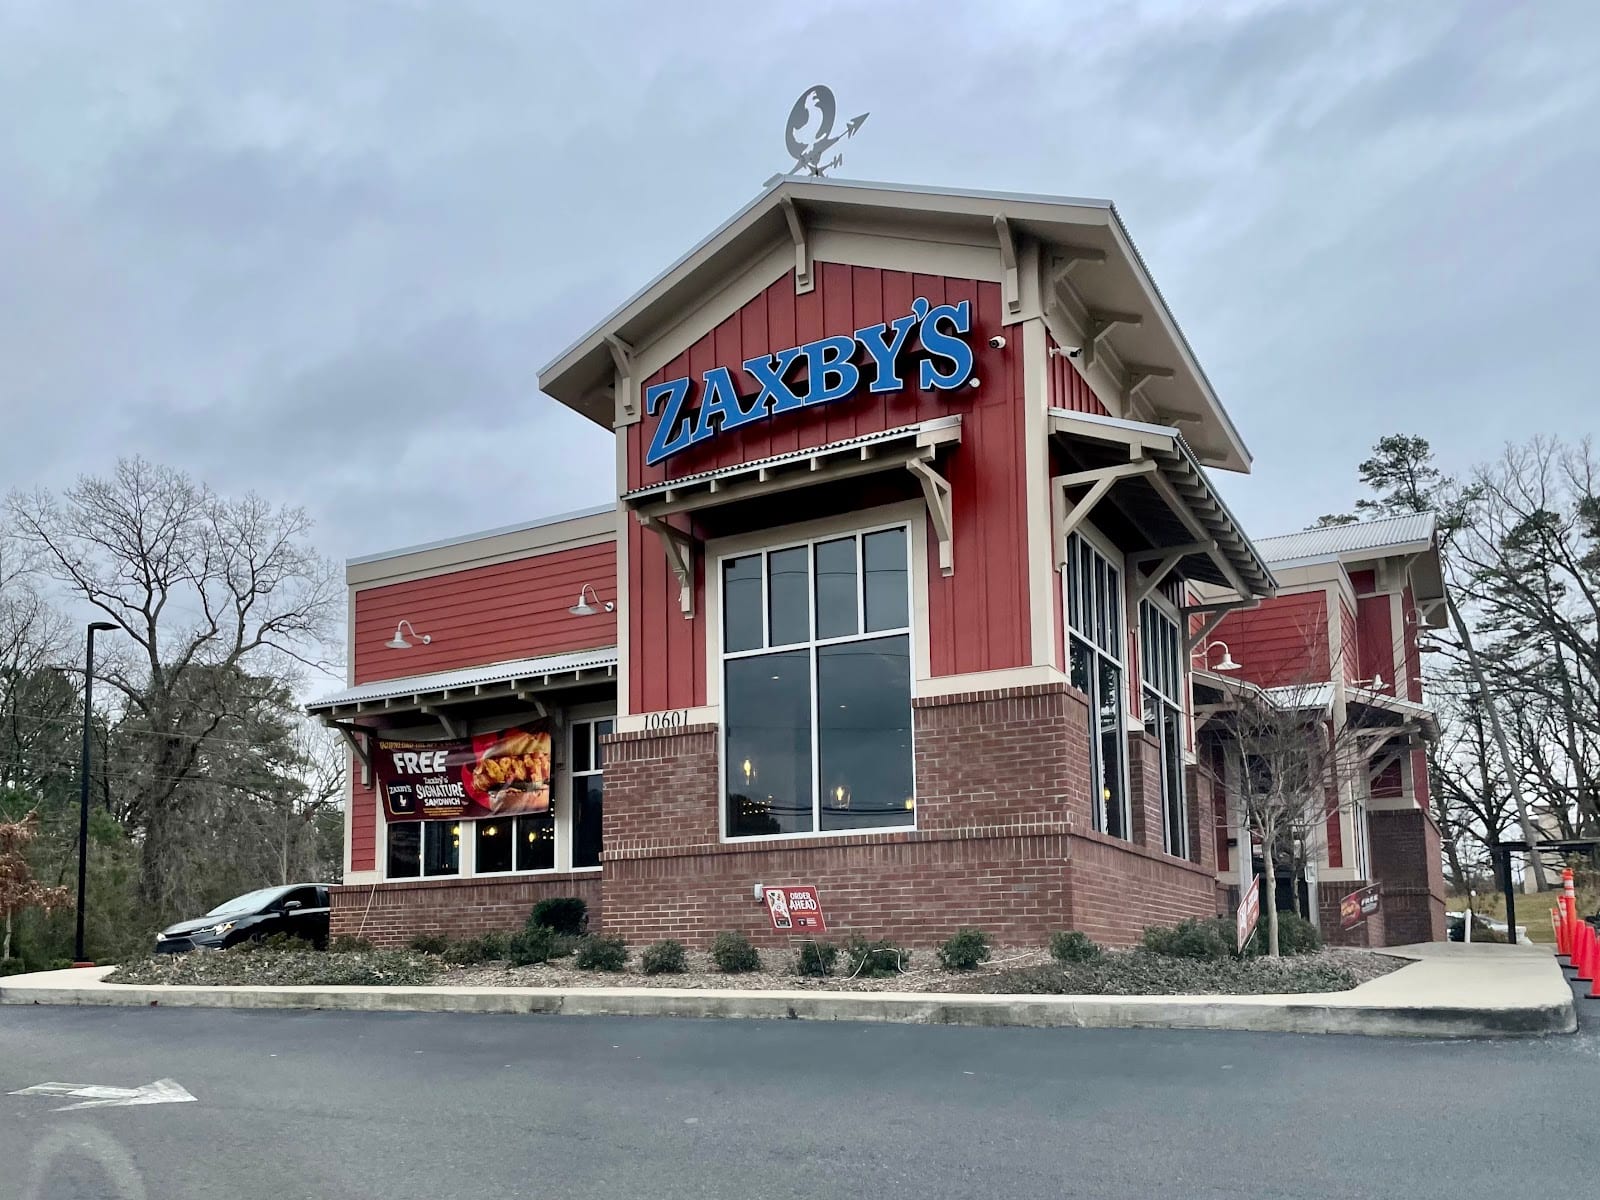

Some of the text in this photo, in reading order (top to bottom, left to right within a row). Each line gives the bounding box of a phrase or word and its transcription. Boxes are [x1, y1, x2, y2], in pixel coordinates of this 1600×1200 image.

[646, 297, 974, 466] ZAXBY'S
[644, 709, 688, 731] 10601
[393, 751, 448, 774] FREE
[416, 782, 465, 799] SIGNATURE
[424, 798, 460, 806] SANDWICH
[790, 899, 817, 910] AHEAD
